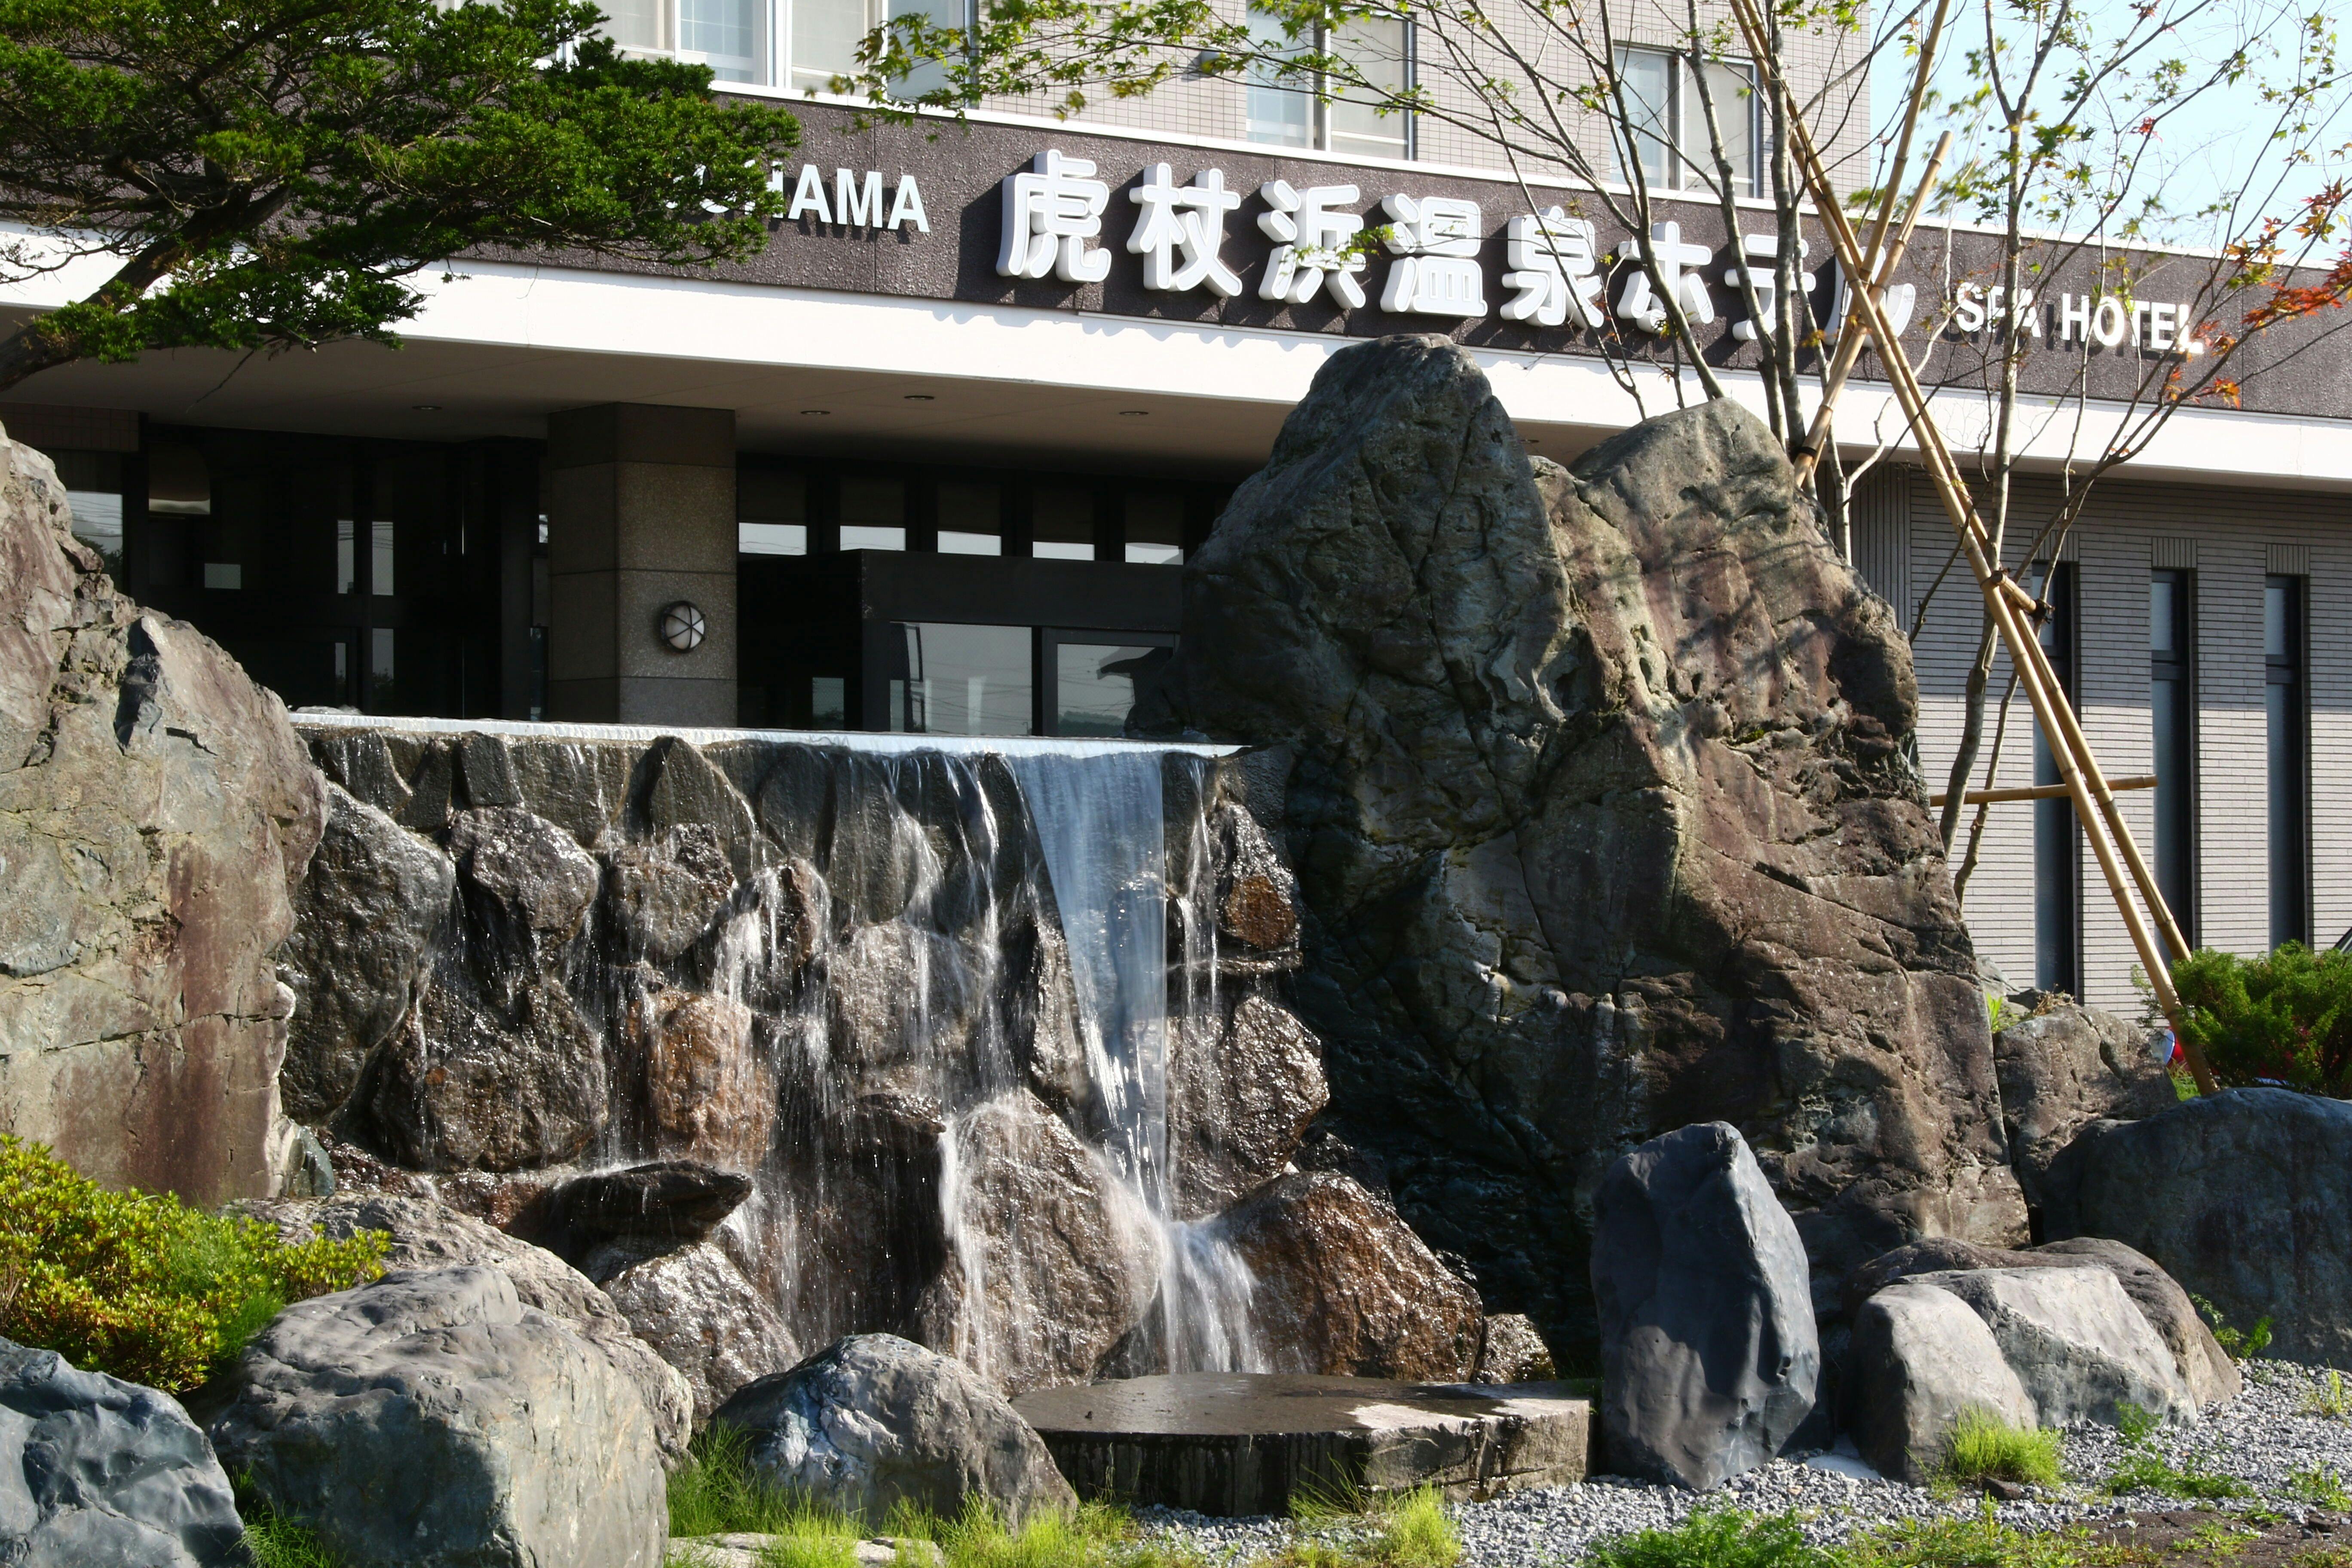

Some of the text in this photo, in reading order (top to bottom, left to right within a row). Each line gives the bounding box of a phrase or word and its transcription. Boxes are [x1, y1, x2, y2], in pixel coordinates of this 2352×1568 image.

[996, 149, 1916, 347] 虎杖浜温泉ホテル
[1957, 282, 2204, 354] SPA HOTEL
